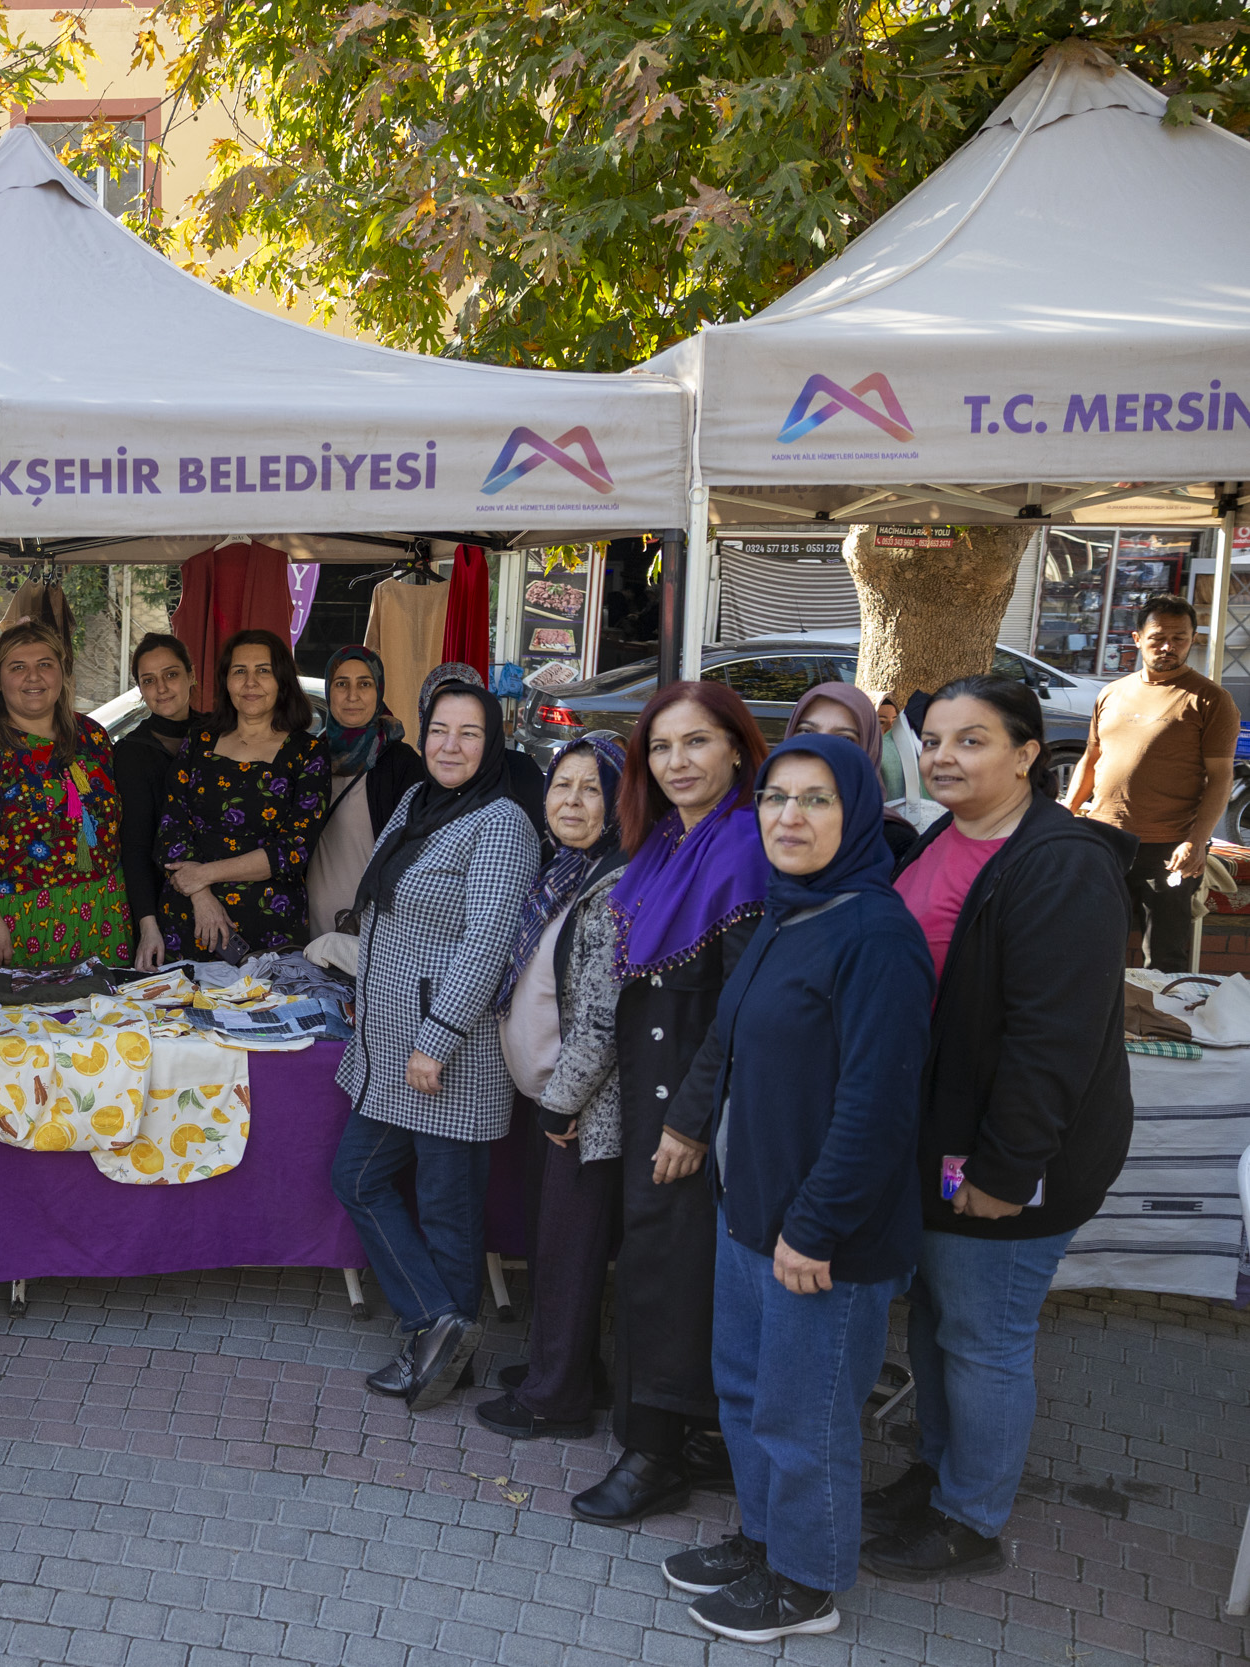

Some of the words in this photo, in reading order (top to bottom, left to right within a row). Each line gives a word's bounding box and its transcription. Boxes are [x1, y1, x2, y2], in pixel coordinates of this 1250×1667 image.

[964, 394, 1048, 434] T.C.
[1063, 379, 1250, 433] MERSİN
[179, 440, 437, 494] BELEDİYESİ
[817, 452, 854, 460] HİZMETLERİ
[881, 451, 919, 460] BAŞKANLIĞI
[745, 543, 765, 553] 0324
[766, 543, 780, 553] 577
[781, 543, 789, 553] 12
[791, 543, 799, 553] 15
[806, 543, 825, 553] 0551
[826, 543, 840, 553] 272
